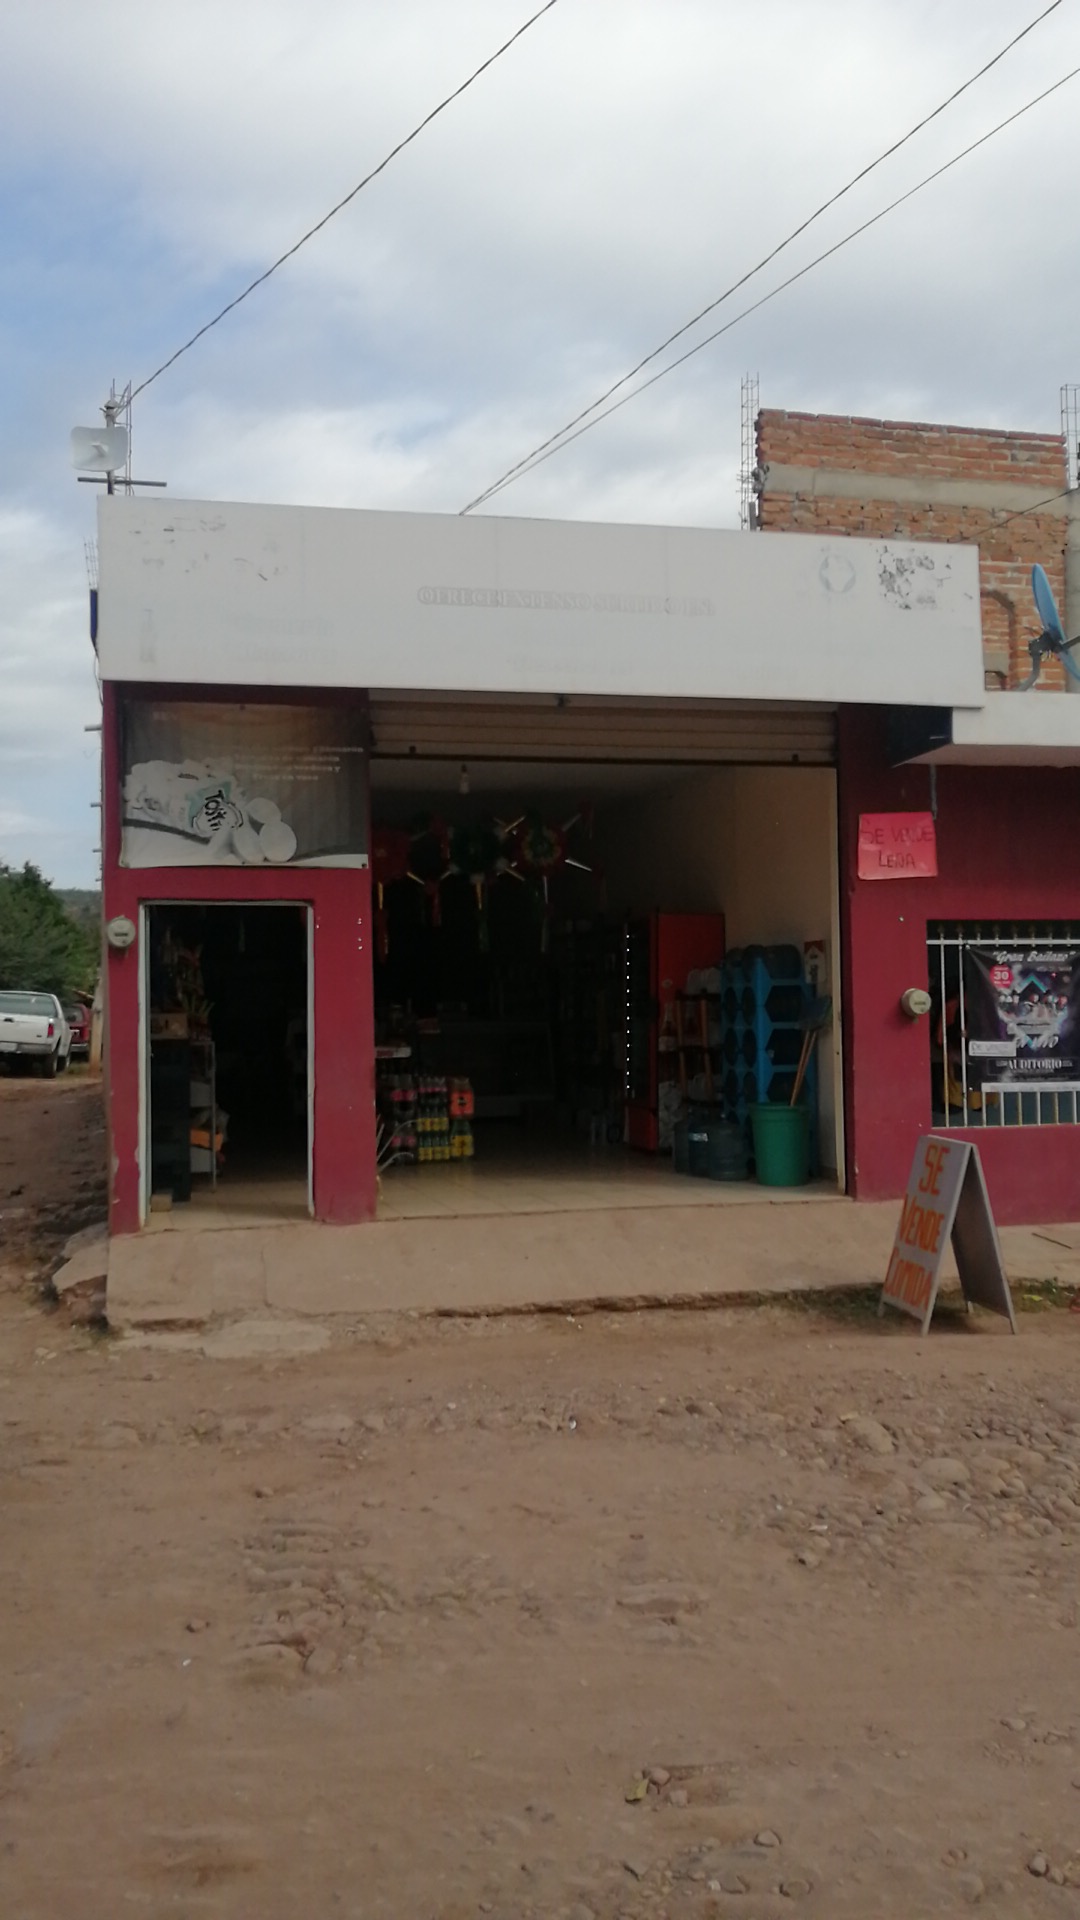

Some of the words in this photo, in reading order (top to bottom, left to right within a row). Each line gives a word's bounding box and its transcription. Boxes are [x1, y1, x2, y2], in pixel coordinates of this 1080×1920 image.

[860, 818, 884, 845] SE
[994, 971, 1009, 980] 30
[1009, 1059, 1062, 1070] AUDITORIO
[918, 1143, 950, 1196] SE
[899, 1194, 945, 1253] VENDE
[883, 1246, 933, 1311] COMIDA
